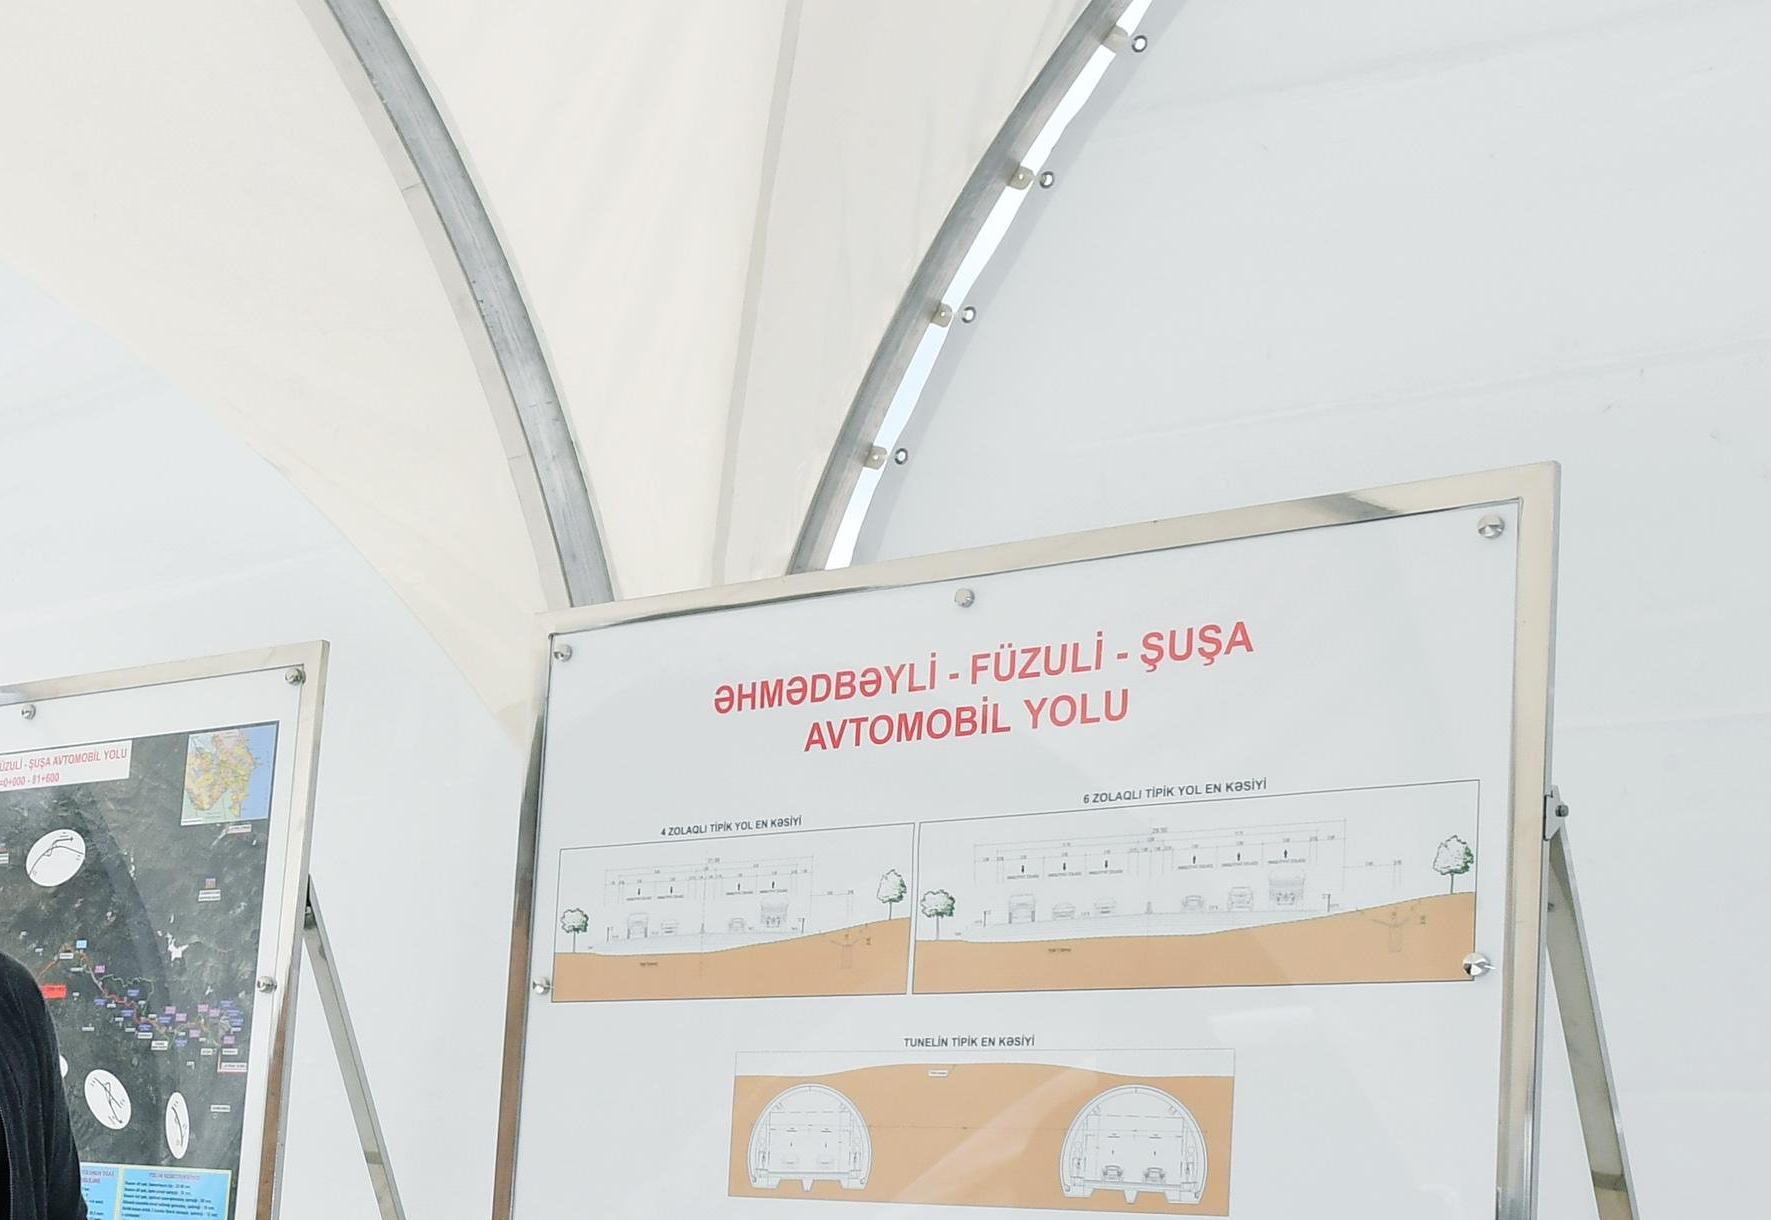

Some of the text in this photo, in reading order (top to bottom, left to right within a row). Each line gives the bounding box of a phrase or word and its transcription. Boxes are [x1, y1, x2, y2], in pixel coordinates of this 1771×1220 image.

[713, 652, 937, 715] ƏHMƏDBƏYLİ
[970, 632, 1104, 684] FÜZULİ
[1139, 621, 1254, 672] ŞUŞA
[804, 688, 1129, 752] AVTOMOBİL YOLU
[103, 748, 128, 760] YOLU
[1082, 776, 1268, 804] 6 ZOLAQLI TİPİK YOL EN KƏSİYİ
[660, 827, 667, 836] 4
[709, 821, 733, 833] TİPİK
[734, 820, 753, 831] YOL
[755, 819, 769, 830] EN
[903, 1034, 1036, 1048] TUNELİN TİPİK EN KƏSİYİ
